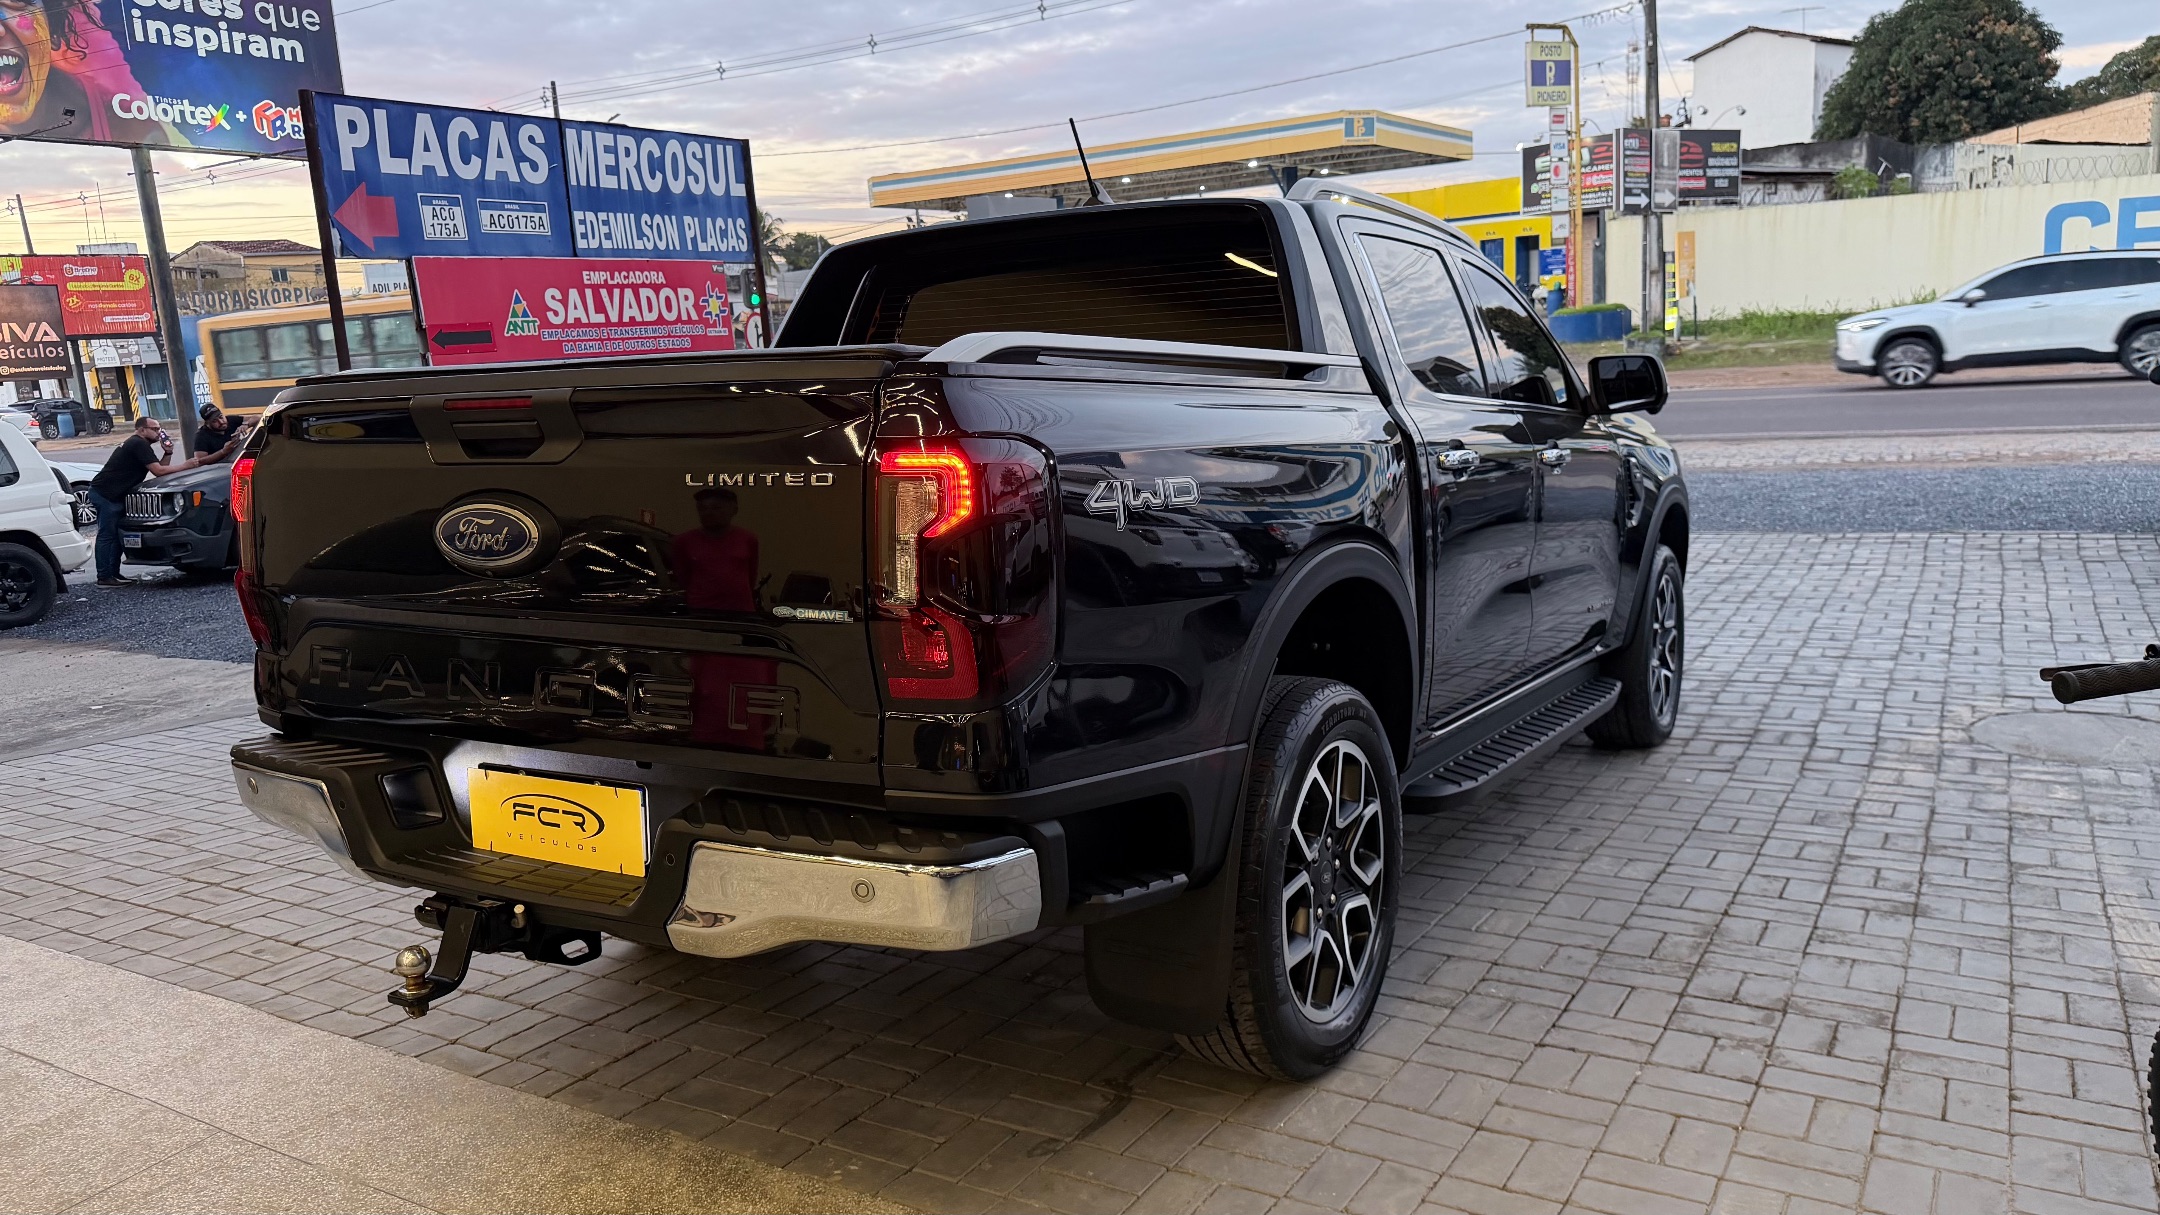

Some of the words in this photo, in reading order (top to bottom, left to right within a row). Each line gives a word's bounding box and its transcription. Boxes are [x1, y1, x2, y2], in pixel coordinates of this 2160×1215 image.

[254, 1, 321, 32] que
[131, 8, 305, 63] inspiram
[1539, 45, 1562, 57] POSTO
[333, 104, 550, 186] PLACAS
[565, 127, 747, 198] MERCOSUL
[430, 223, 461, 237] 175A
[573, 211, 679, 252] EDEMILSON
[683, 216, 748, 252] PLACAS
[372, 283, 391, 294] ADIL
[582, 270, 666, 285] EMPLACADORA
[248, 287, 322, 308] SKORPI
[544, 287, 699, 325] SALVADOR
[0, 321, 61, 343] IVA
[506, 319, 539, 335] ANTT
[541, 327, 600, 341] EMPLACAMOS
[601, 327, 608, 338] E
[608, 325, 668, 338] TRANSFERIMOS
[669, 323, 705, 336] VEÍCULOS
[563, 342, 577, 354] DA
[577, 341, 603, 353] BAHIA
[604, 341, 611, 352] E
[611, 341, 623, 352] DE
[624, 339, 657, 351] OUTROS
[657, 337, 692, 349] ESTADOS
[685, 473, 833, 487] LIMITED
[1083, 476, 1201, 531] 4WD
[454, 516, 510, 552] Ford
[796, 608, 854, 622] CIMAVEL
[309, 643, 802, 735] RANGER
[1321, 706, 1355, 736] TERRITORY
[512, 802, 587, 833] FCR
